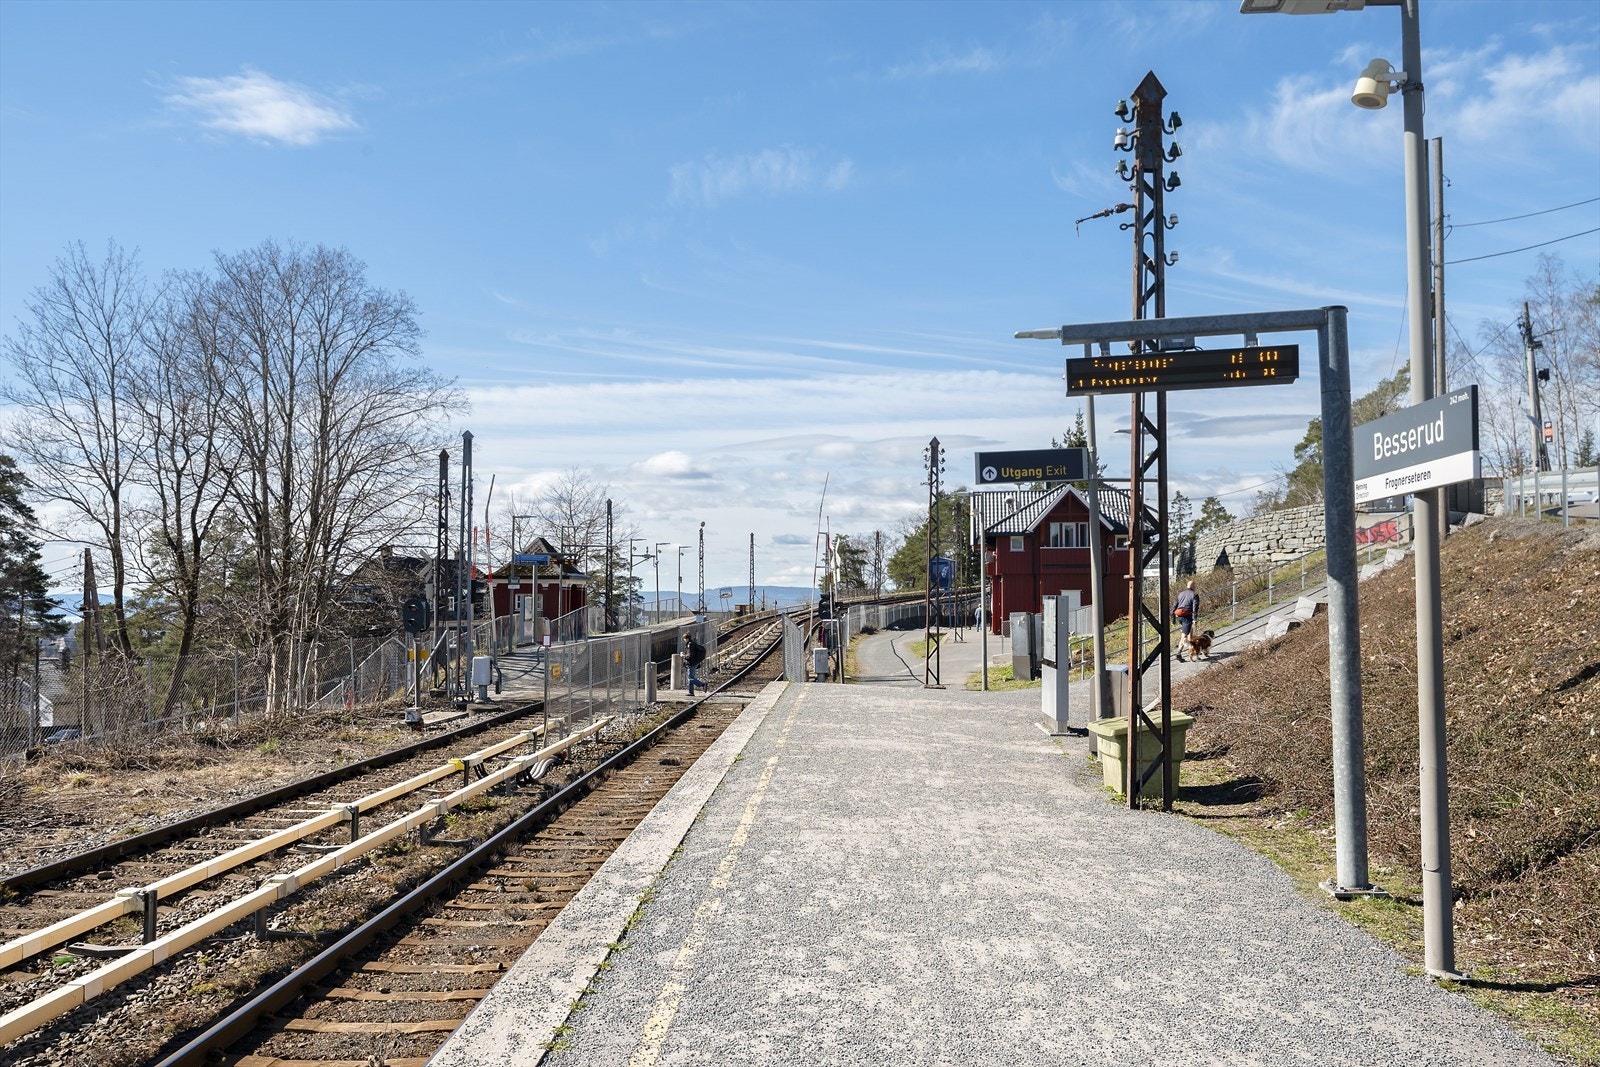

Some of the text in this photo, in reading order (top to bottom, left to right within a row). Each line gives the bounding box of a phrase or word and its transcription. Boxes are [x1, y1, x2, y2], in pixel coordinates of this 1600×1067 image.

[1373, 410, 1444, 461] Besserud
[1001, 465, 1067, 479] Utgang Exit
[1385, 469, 1431, 490] Frognerseteren
